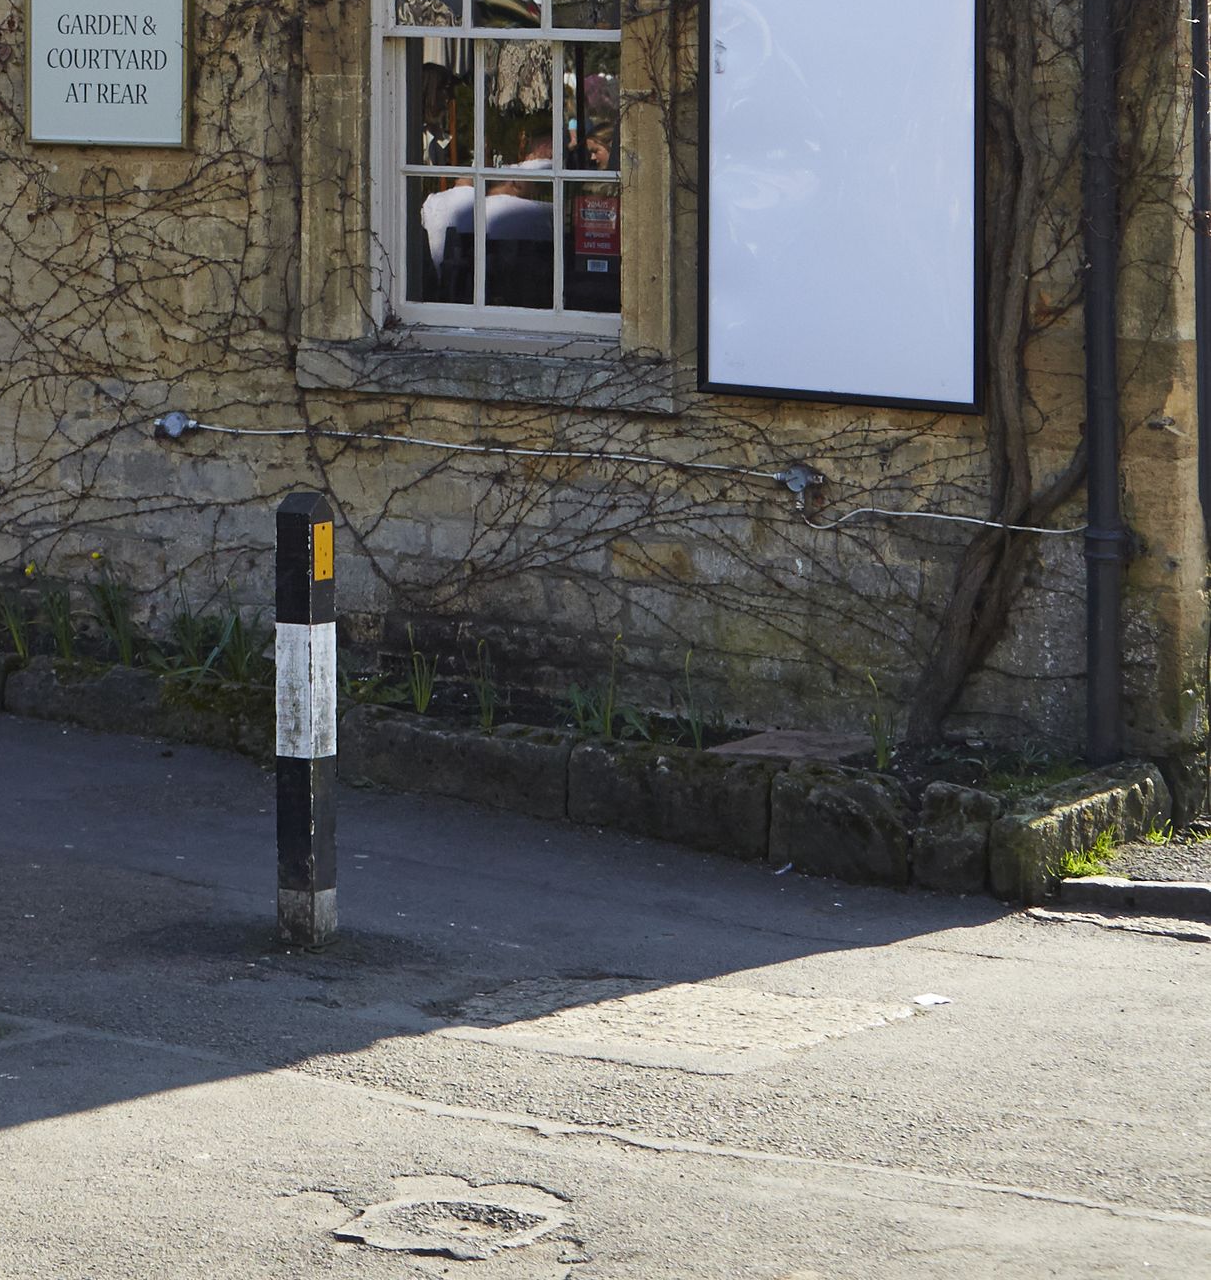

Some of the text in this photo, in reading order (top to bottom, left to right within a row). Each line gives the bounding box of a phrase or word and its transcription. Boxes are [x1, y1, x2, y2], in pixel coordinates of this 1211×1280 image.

[57, 14, 157, 36] GARDEN &
[47, 48, 167, 70] COURTYARD
[65, 83, 148, 104] AT REAR
